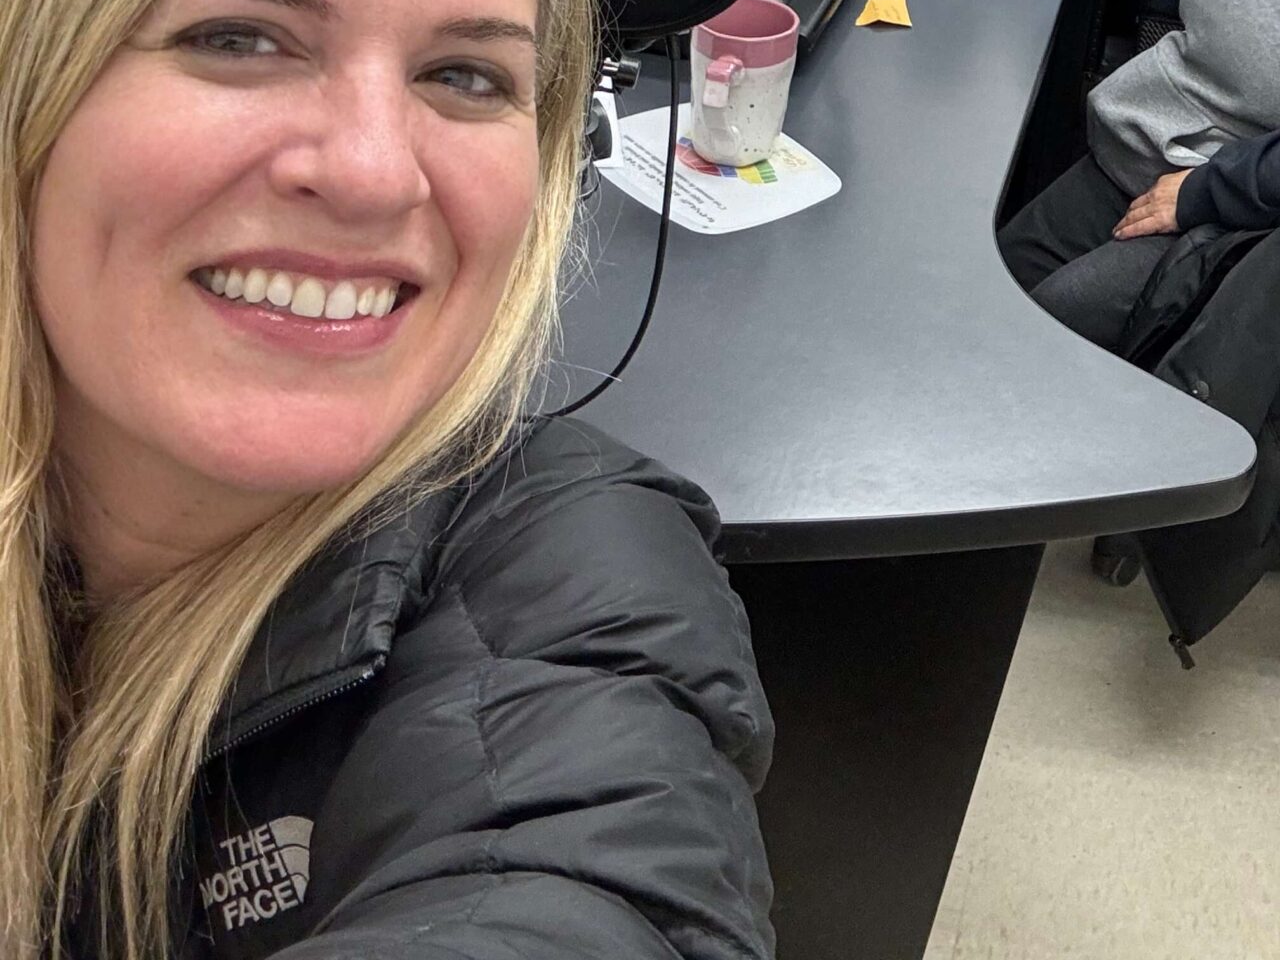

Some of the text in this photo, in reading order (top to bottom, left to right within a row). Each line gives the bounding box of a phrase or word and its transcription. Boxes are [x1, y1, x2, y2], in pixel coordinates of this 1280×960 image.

[220, 825, 276, 866] THE
[199, 851, 287, 909] NORTH
[222, 880, 299, 931] FACE
